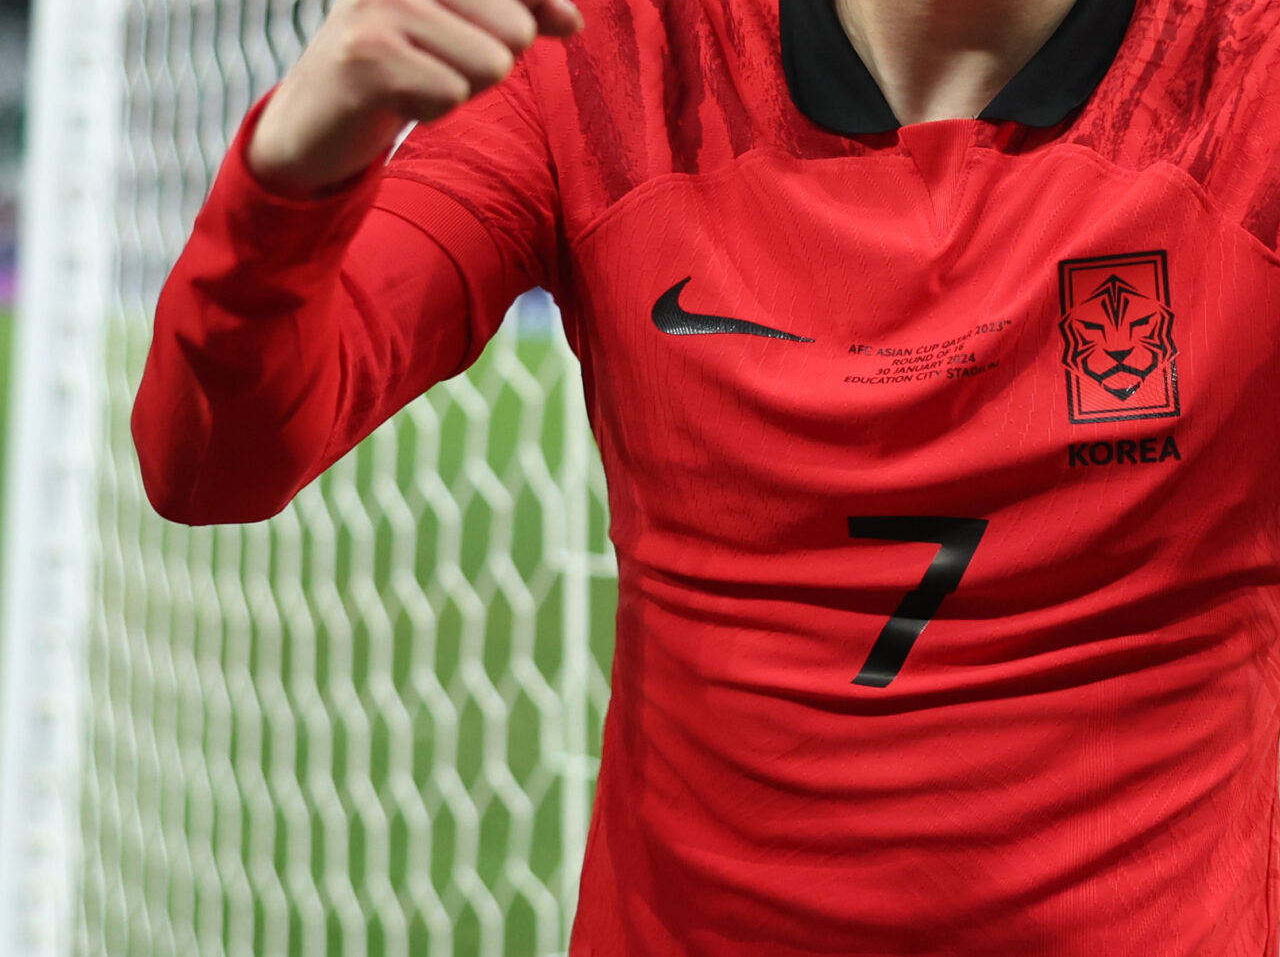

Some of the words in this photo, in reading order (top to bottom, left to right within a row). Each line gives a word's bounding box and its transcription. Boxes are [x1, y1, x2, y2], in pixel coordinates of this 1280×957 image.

[848, 344, 872, 355] AFC
[877, 347, 913, 357] ASIAN
[916, 344, 939, 355] CUP
[892, 354, 933, 366] ROUND
[936, 349, 951, 359] OF
[954, 342, 965, 353] 16
[876, 368, 891, 376] 30
[893, 359, 944, 374] JANUARY
[947, 352, 976, 364] 2024
[844, 374, 913, 384] EDUCATION
[916, 370, 941, 381] CITY
[1069, 436, 1181, 467] KOREA
[847, 515, 989, 688] 7
